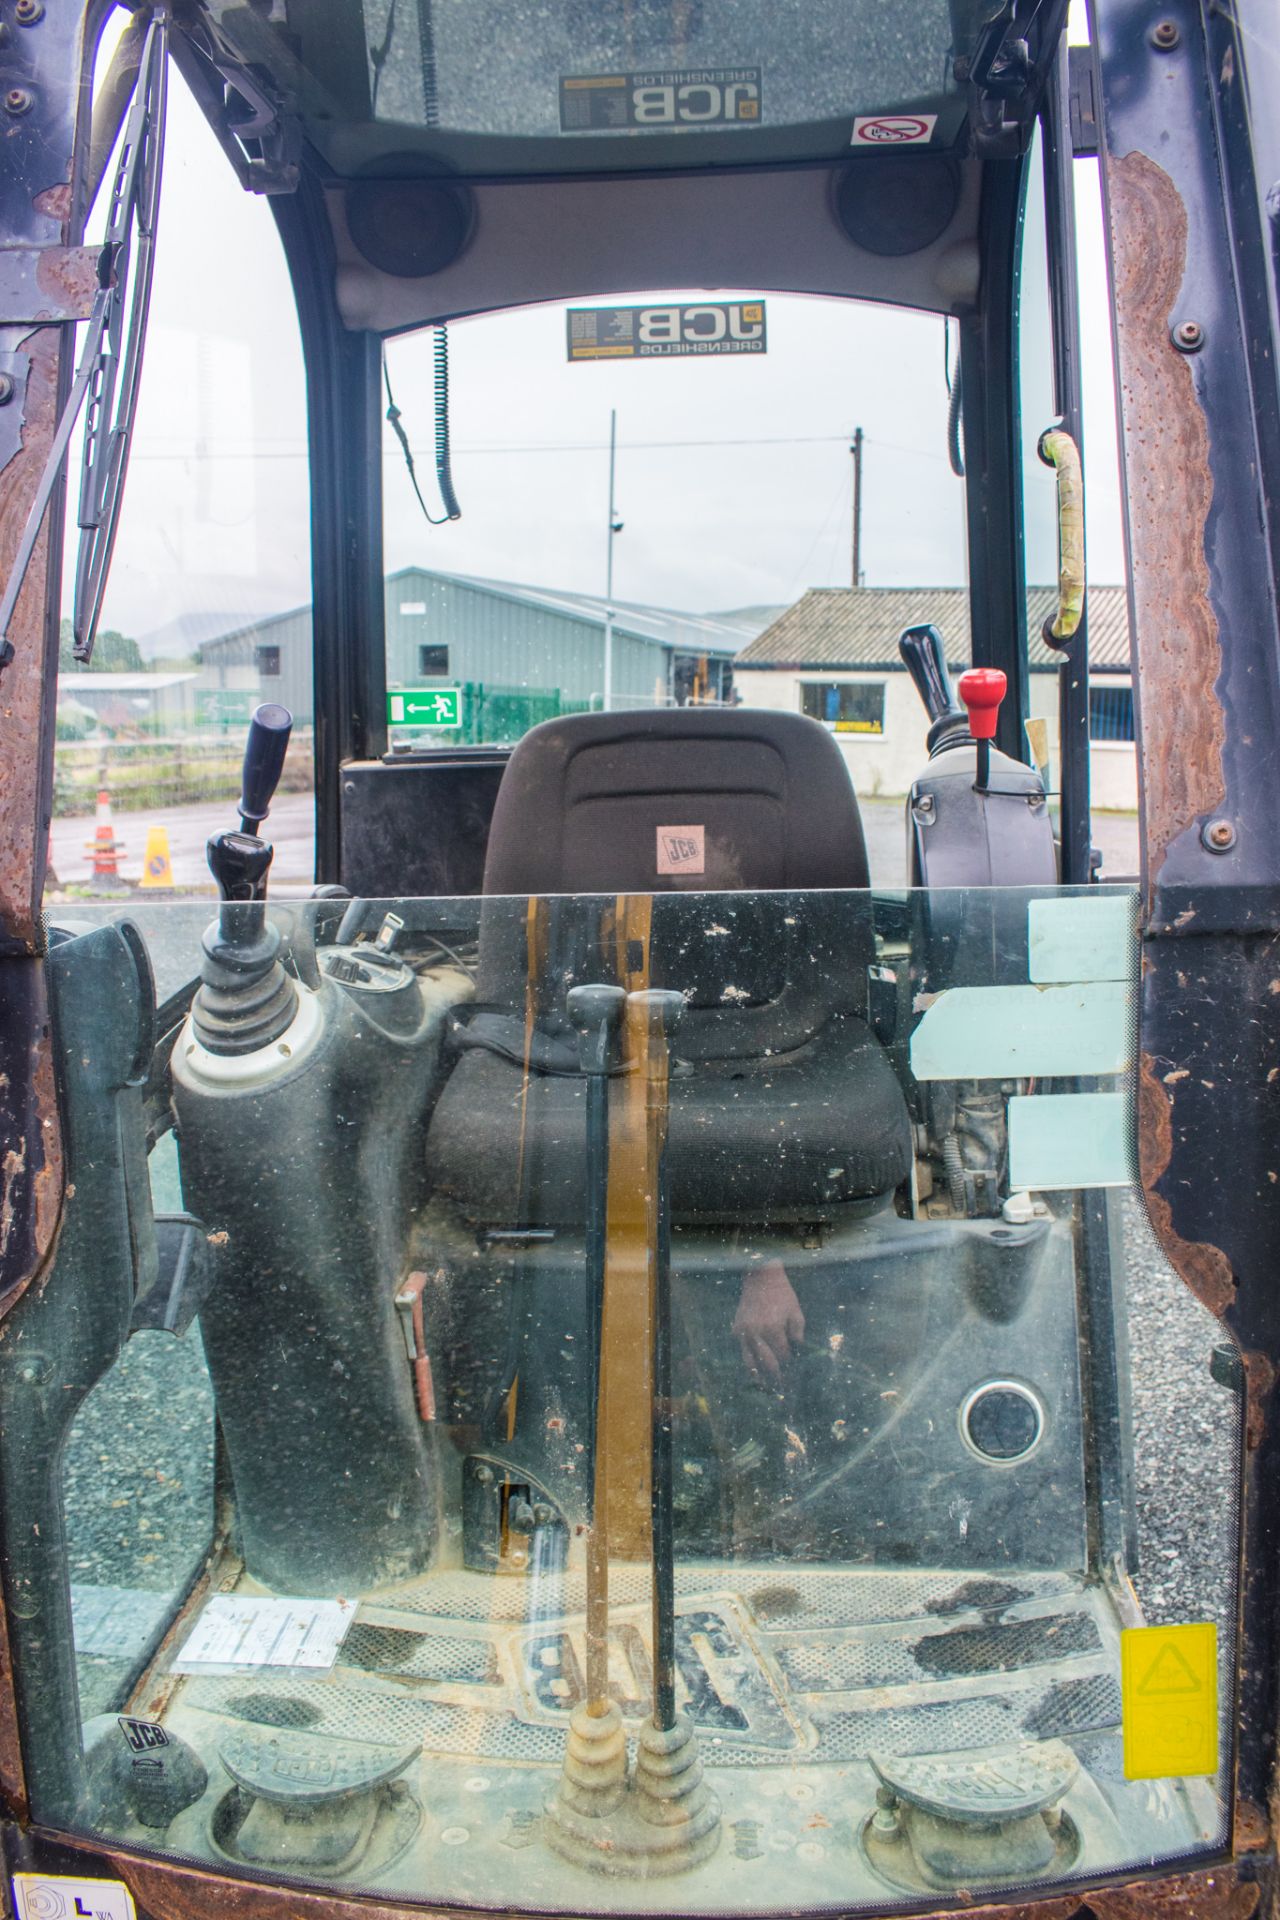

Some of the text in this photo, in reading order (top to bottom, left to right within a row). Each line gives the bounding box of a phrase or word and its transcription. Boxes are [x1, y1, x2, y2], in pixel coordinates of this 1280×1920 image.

[632, 83, 759, 123] JCB
[669, 838, 697, 861] JCB
[127, 1721, 166, 1749] JCB
